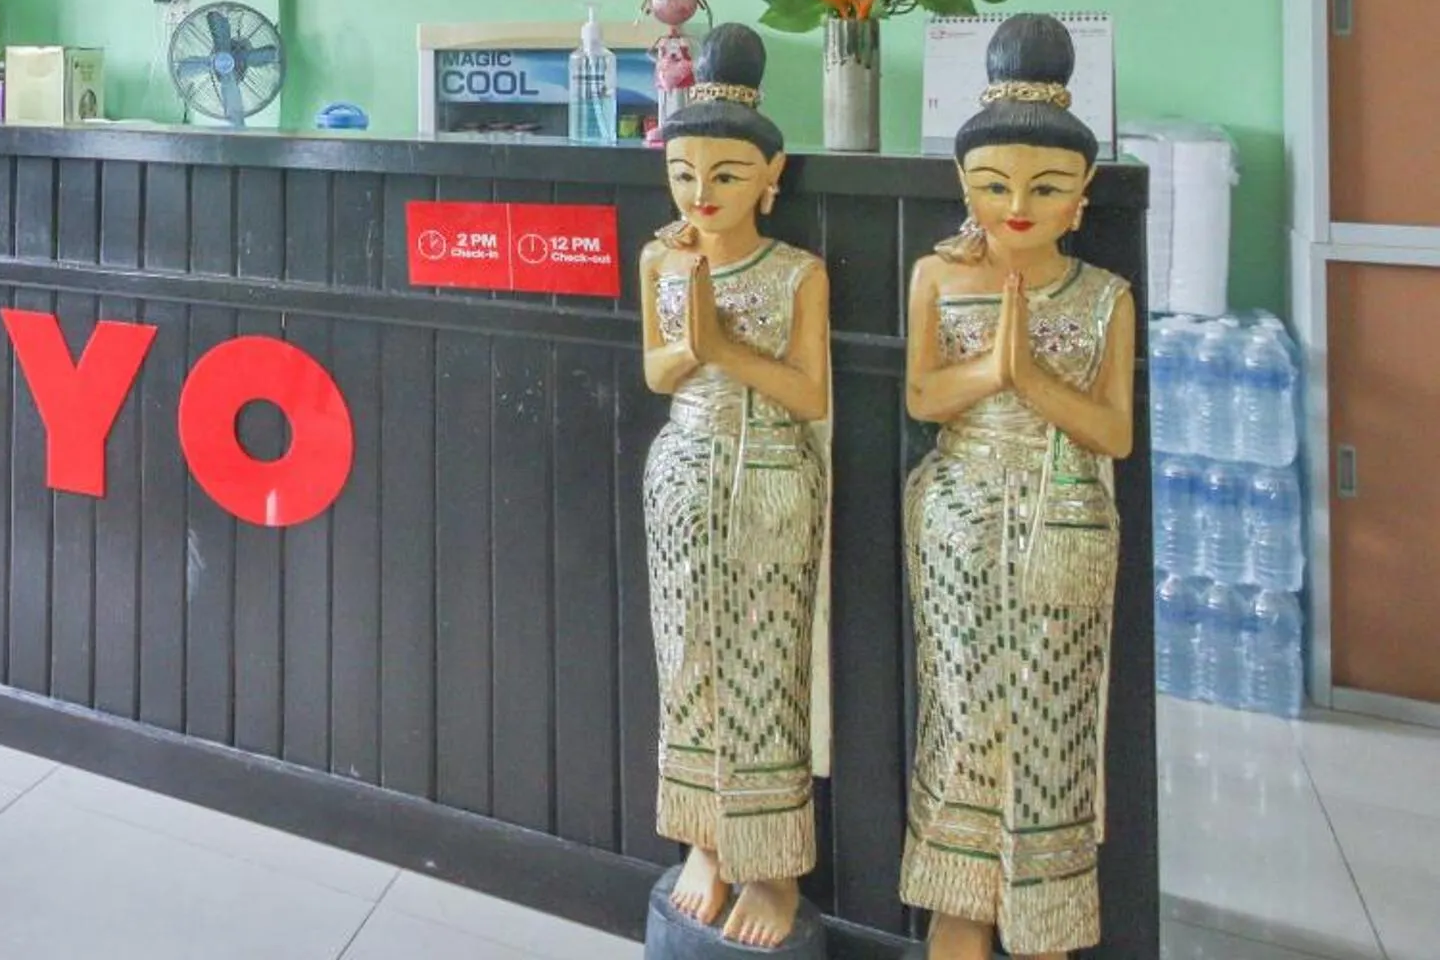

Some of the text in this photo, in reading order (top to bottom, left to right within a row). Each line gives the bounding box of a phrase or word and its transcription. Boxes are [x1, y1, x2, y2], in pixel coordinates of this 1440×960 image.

[442, 50, 511, 67] MAGIC
[442, 70, 539, 95] COOL
[456, 233, 497, 248] 2 PM
[550, 237, 600, 252] 12 PM
[450, 248, 499, 260] Check-in
[550, 252, 611, 264] Check-out
